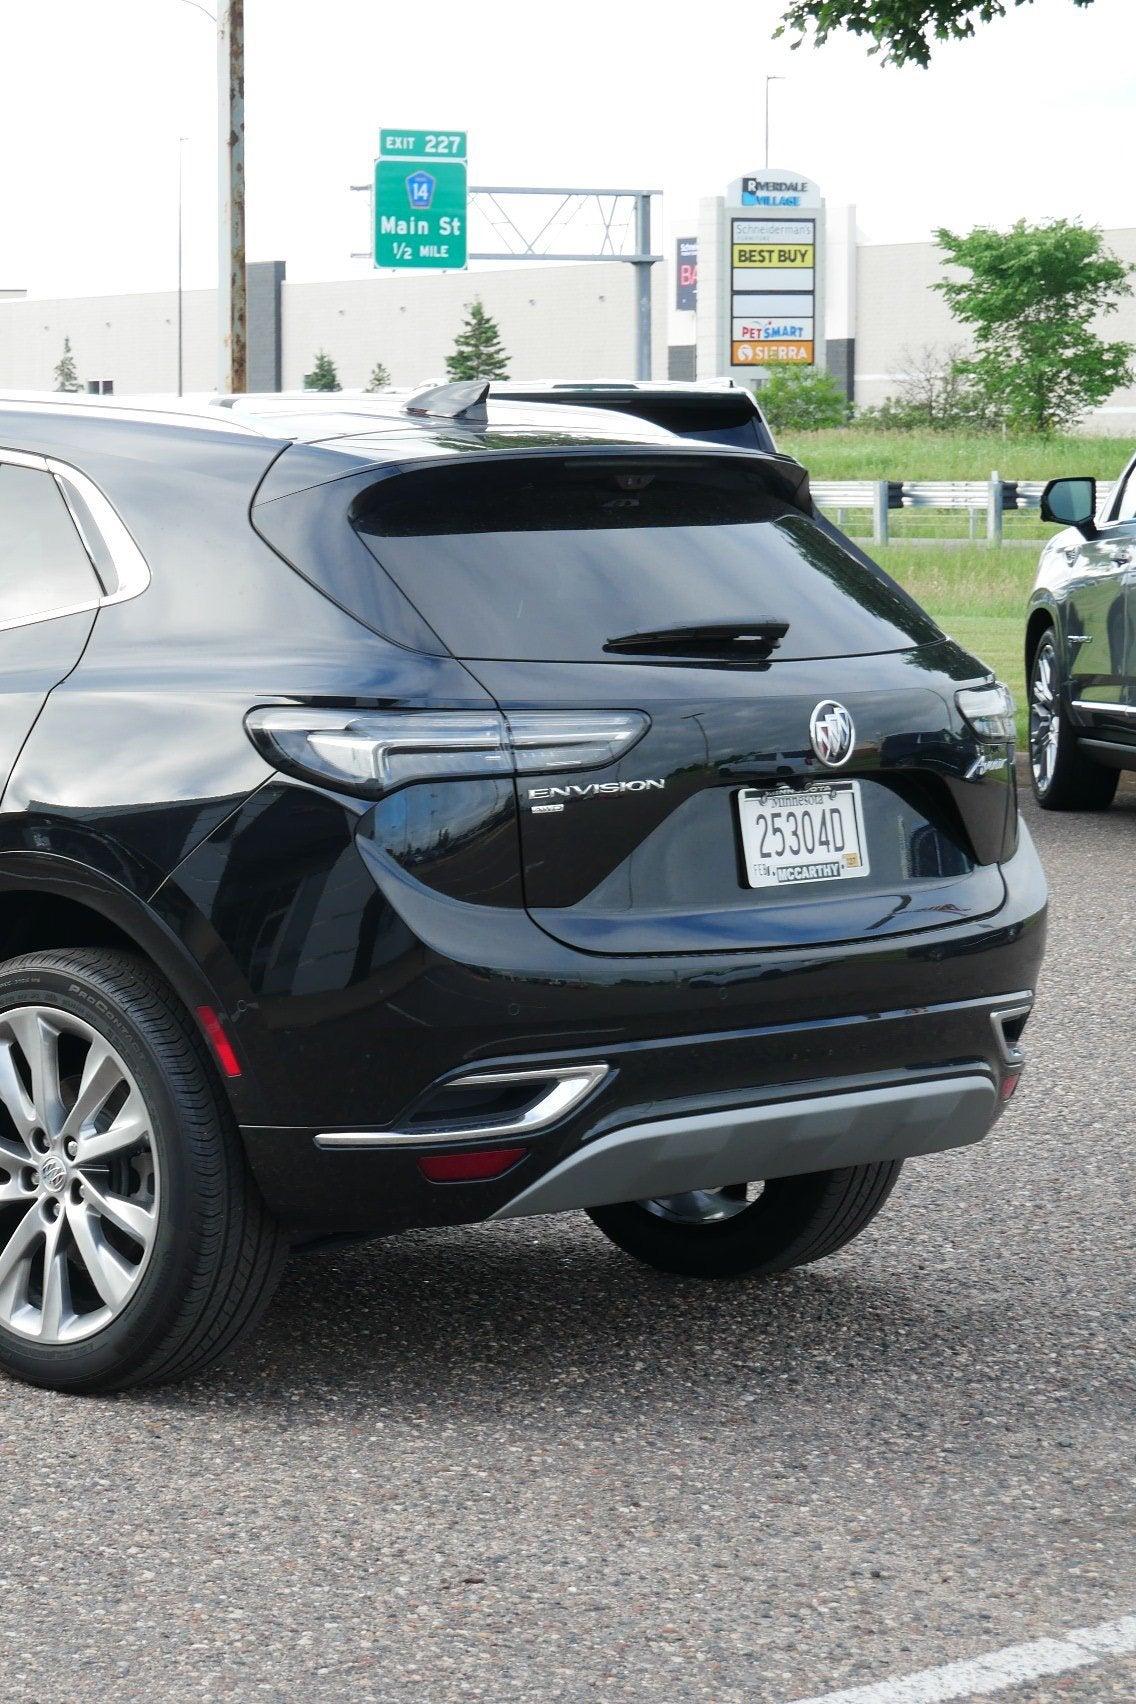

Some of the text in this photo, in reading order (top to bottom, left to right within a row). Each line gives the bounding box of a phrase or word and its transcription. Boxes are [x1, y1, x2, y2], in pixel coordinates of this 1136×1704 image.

[386, 135, 461, 153] EXIT 227
[413, 183, 428, 200] 14
[756, 196, 800, 206] VILLAGE
[381, 216, 461, 235] Main St
[419, 245, 449, 257] MILE
[738, 250, 808, 263] BEST BUY
[755, 346, 808, 360] SIERRA
[528, 778, 665, 800] ENVISION
[756, 807, 845, 859] 25304D
[778, 863, 839, 881] MCCARTHY
